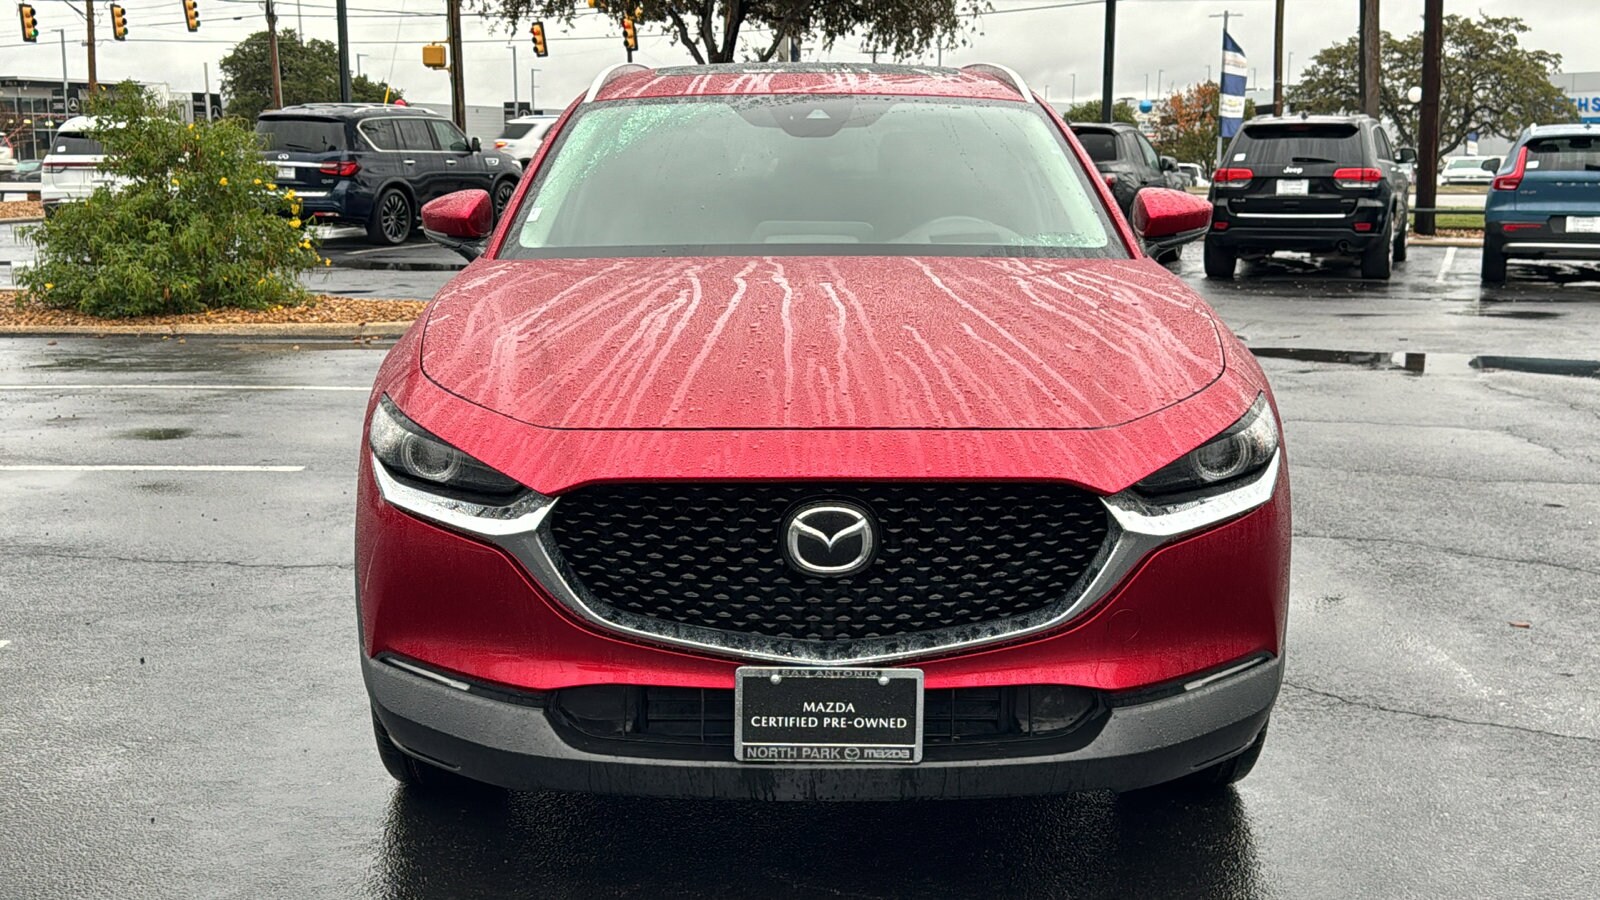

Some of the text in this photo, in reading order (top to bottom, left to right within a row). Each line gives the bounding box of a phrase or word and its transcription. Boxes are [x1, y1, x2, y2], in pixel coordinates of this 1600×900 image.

[1283, 166, 1303, 174] Jeep
[815, 669, 878, 677] ANTONIO
[802, 702, 856, 713] MAZDA
[750, 715, 908, 729] CERTIFIED PRE-OWNED
[747, 746, 910, 759] NORTH PARK mazda
